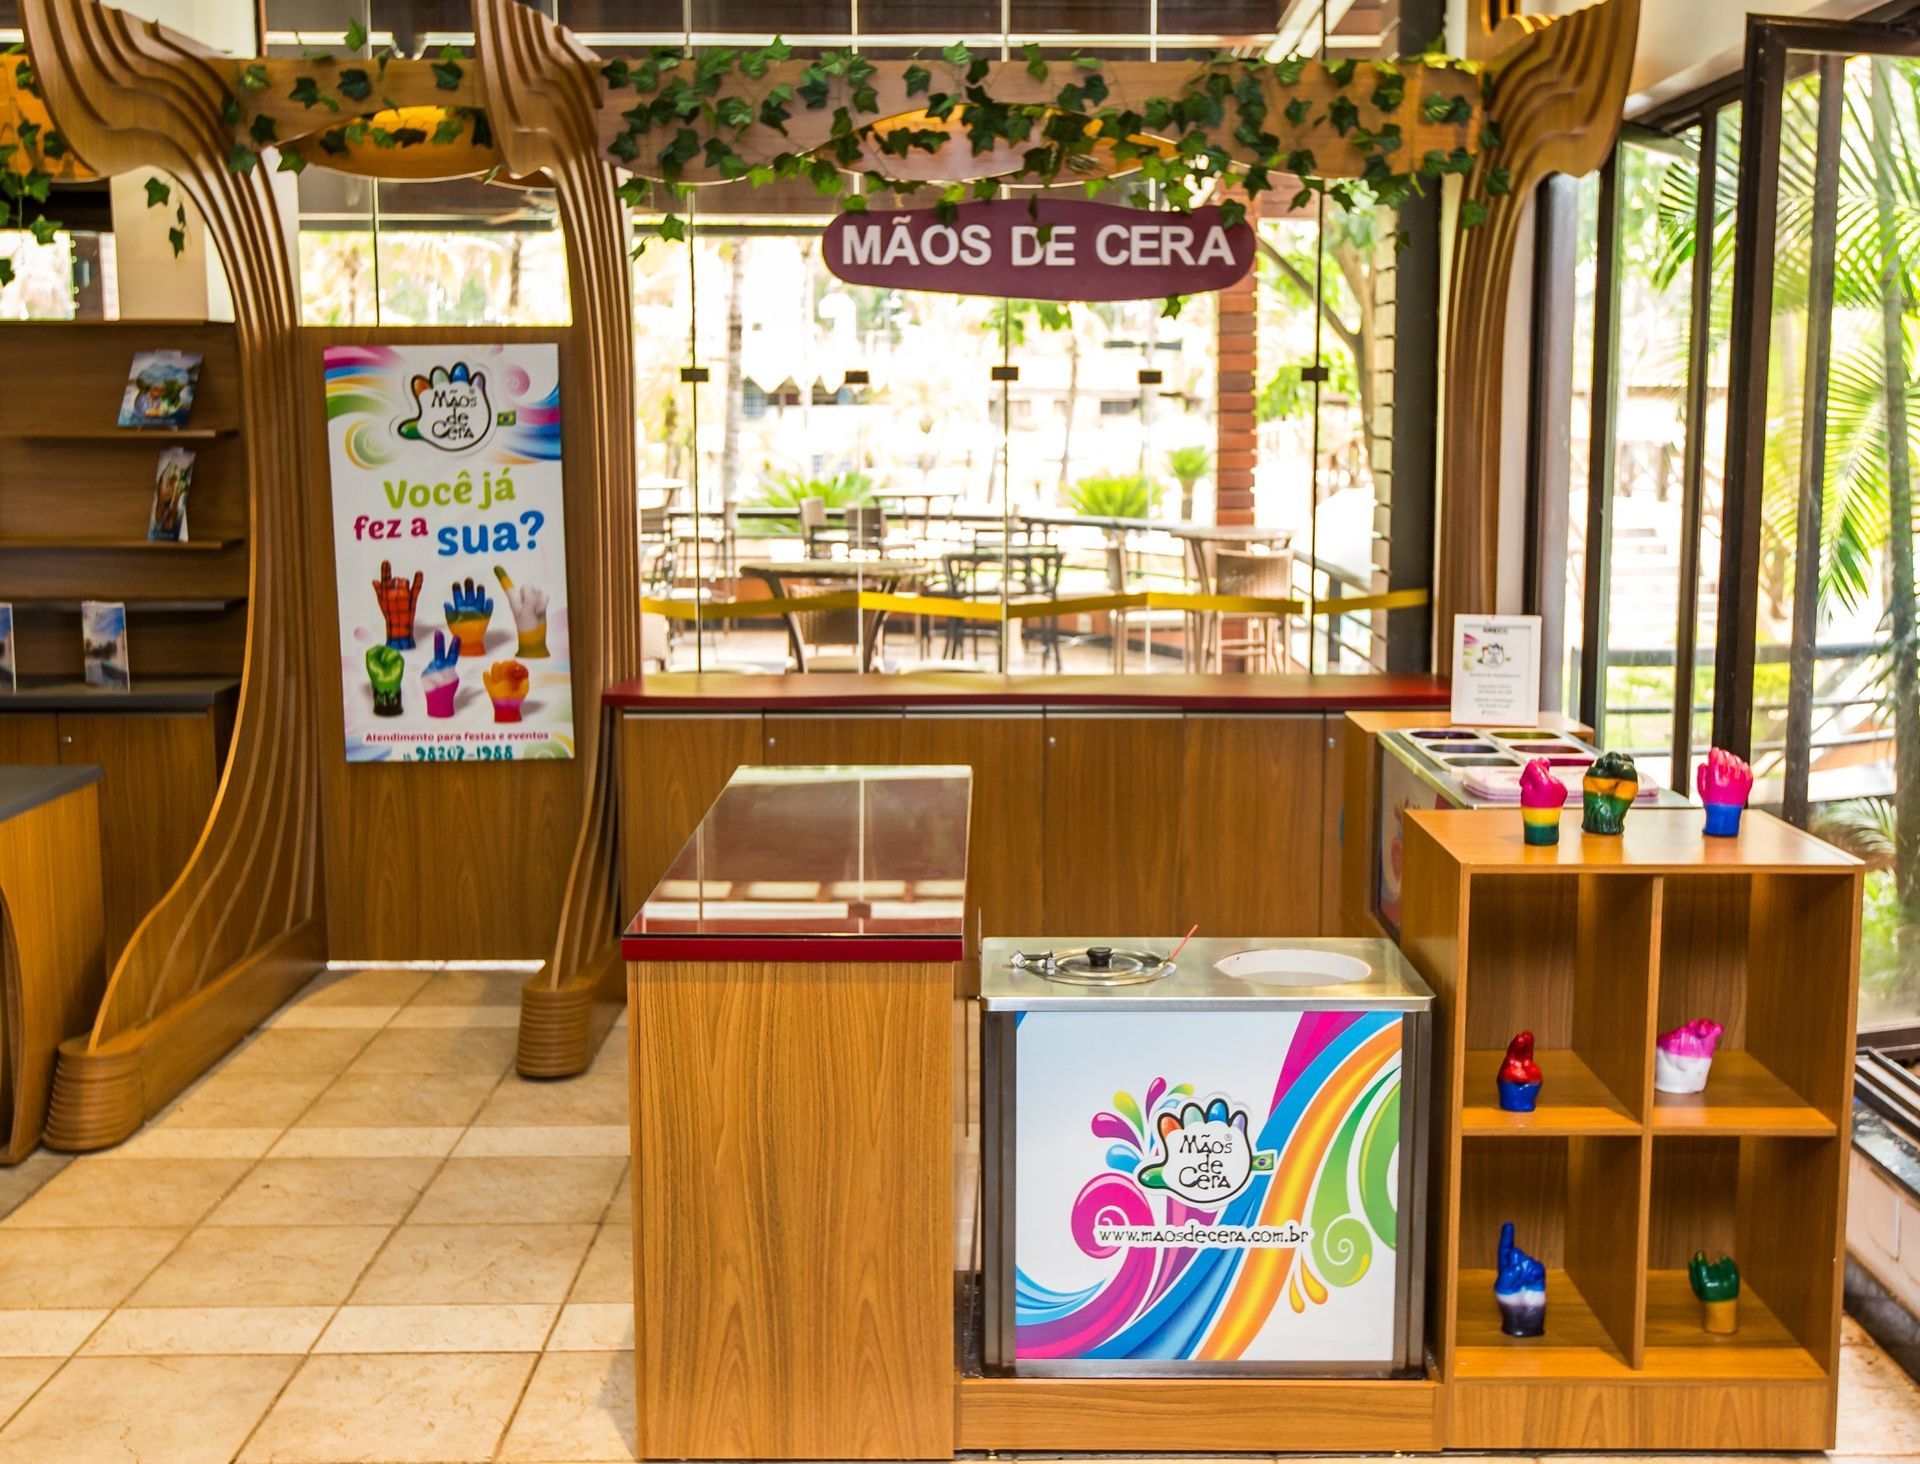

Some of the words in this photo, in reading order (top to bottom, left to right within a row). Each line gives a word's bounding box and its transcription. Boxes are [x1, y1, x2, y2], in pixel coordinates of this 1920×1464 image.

[842, 216, 992, 266] MÃOS
[1012, 225, 1077, 266] DE
[1096, 224, 1235, 266] CERA
[446, 407, 469, 426] de
[383, 470, 474, 509] Você
[478, 467, 516, 511] já
[354, 515, 402, 541] fez
[411, 516, 429, 537] a
[437, 510, 546, 557] sua?
[365, 732, 434, 743] Atendimento
[437, 733, 462, 743] para
[464, 731, 496, 741] festas
[498, 732, 505, 741] e
[507, 731, 549, 741] eventos
[1197, 1153, 1223, 1174] de
[1099, 1225, 1309, 1244] www.maosdecera.com.br
